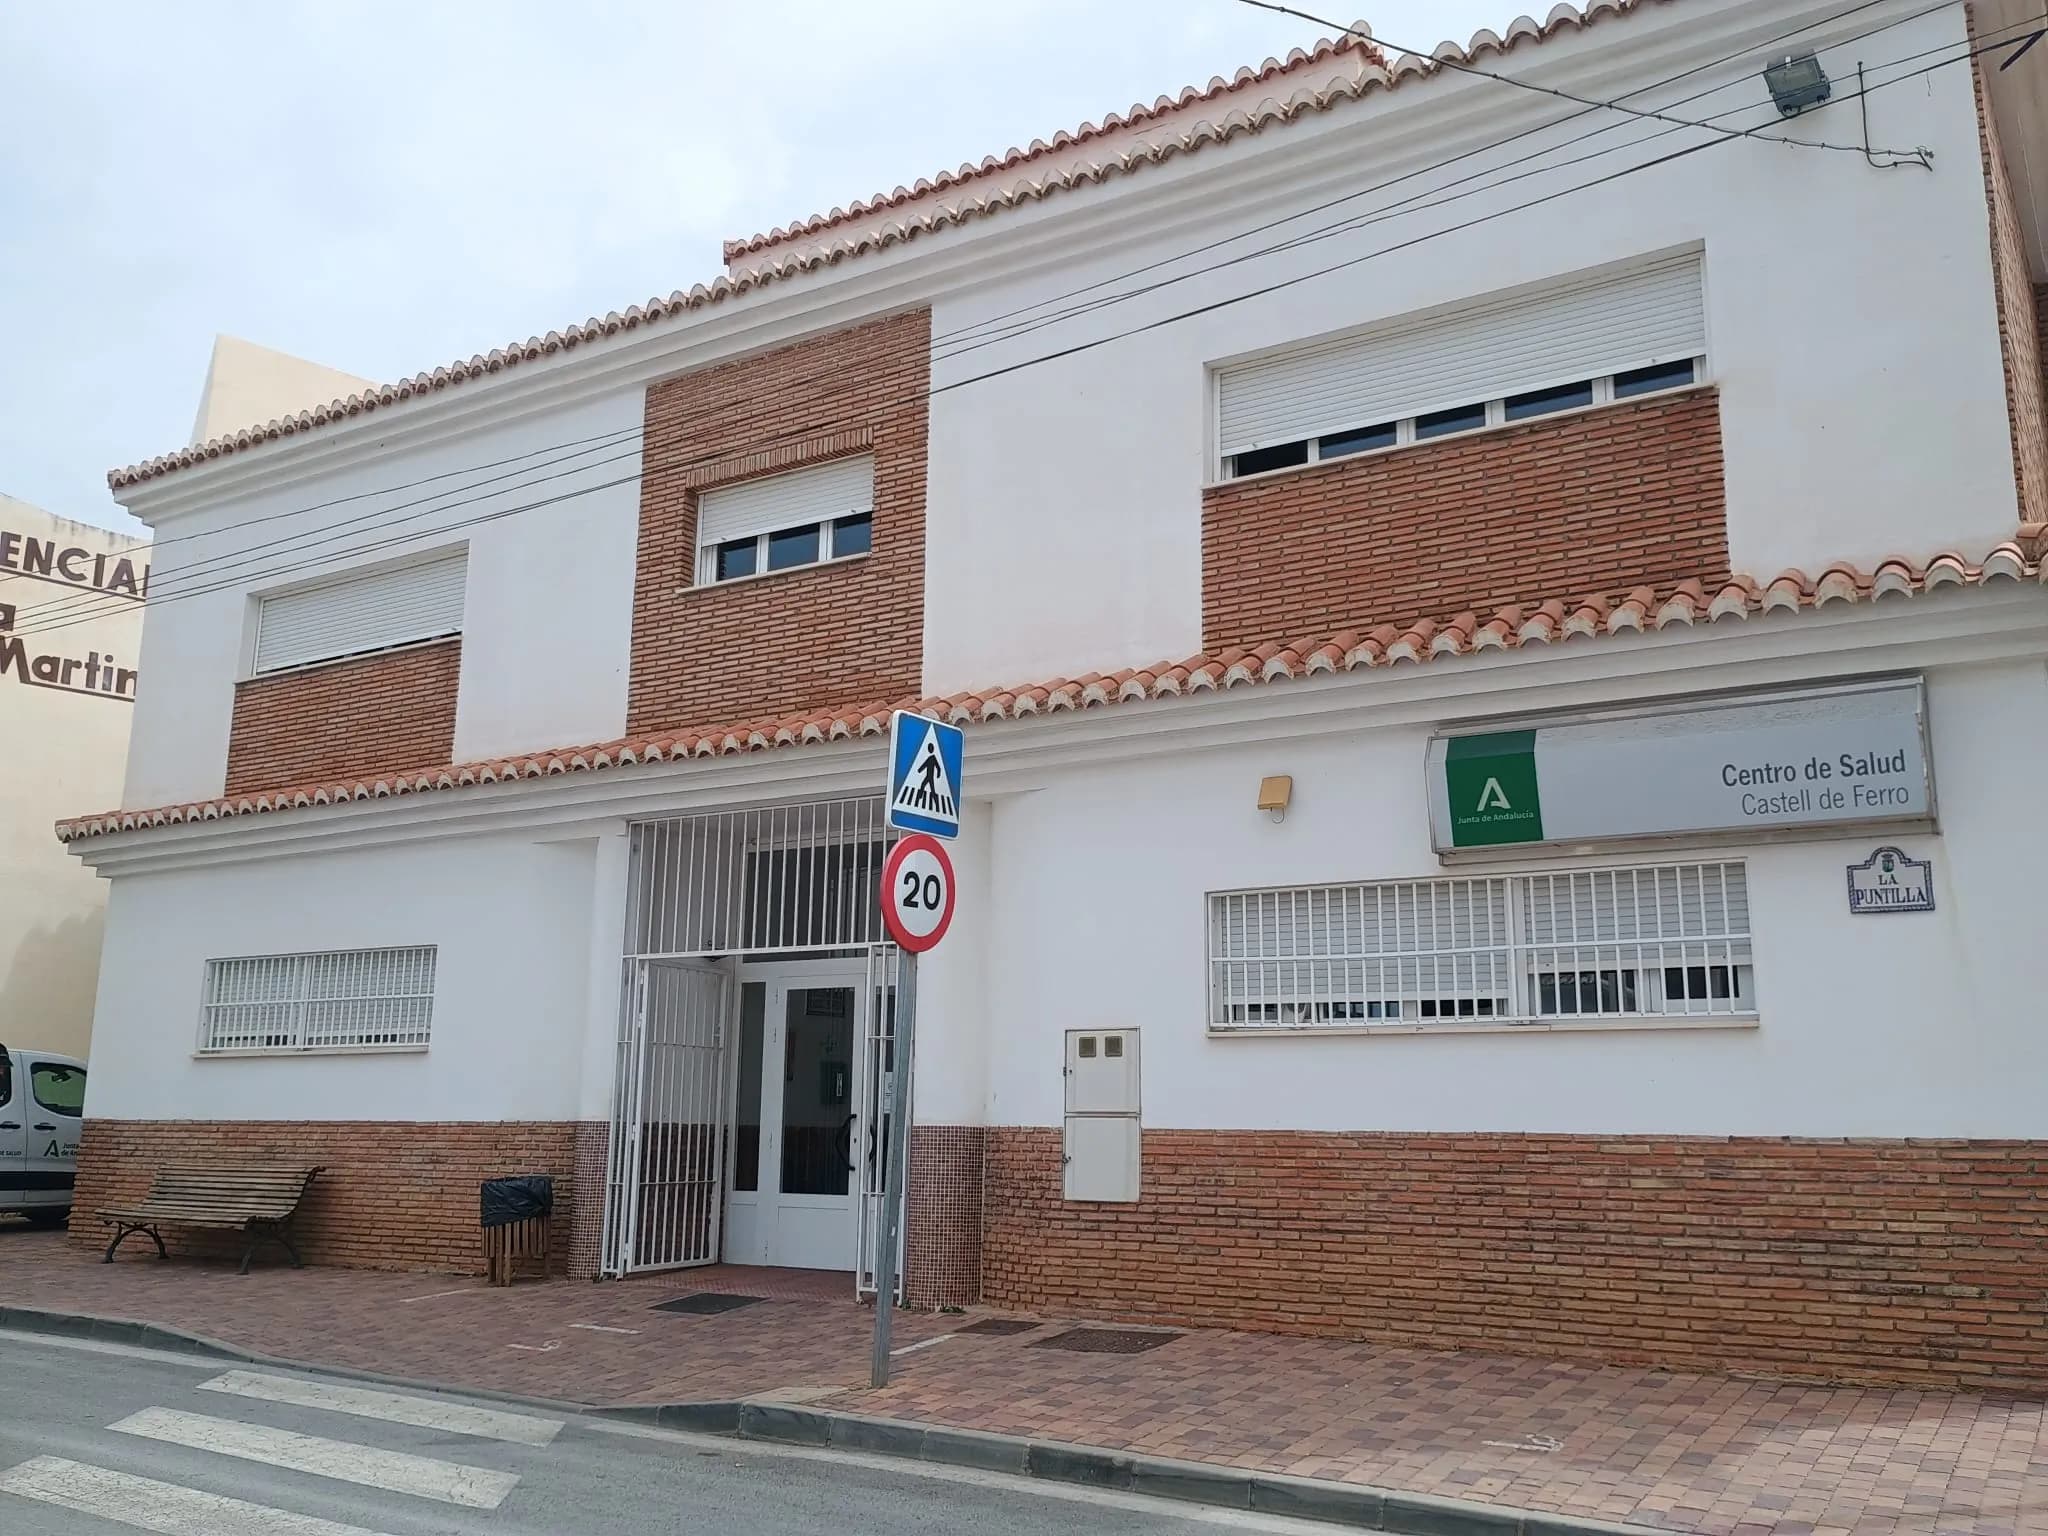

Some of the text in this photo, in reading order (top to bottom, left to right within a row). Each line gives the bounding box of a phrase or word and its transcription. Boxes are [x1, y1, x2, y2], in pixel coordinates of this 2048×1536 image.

[1722, 749, 1906, 787] Centro de Salud
[1742, 784, 1909, 815] Castell de Ferro
[1494, 810, 1534, 821] Andalucía
[903, 871, 941, 911] 20
[1878, 874, 1898, 885] LA
[1855, 887, 1927, 905] PUNTILLA
